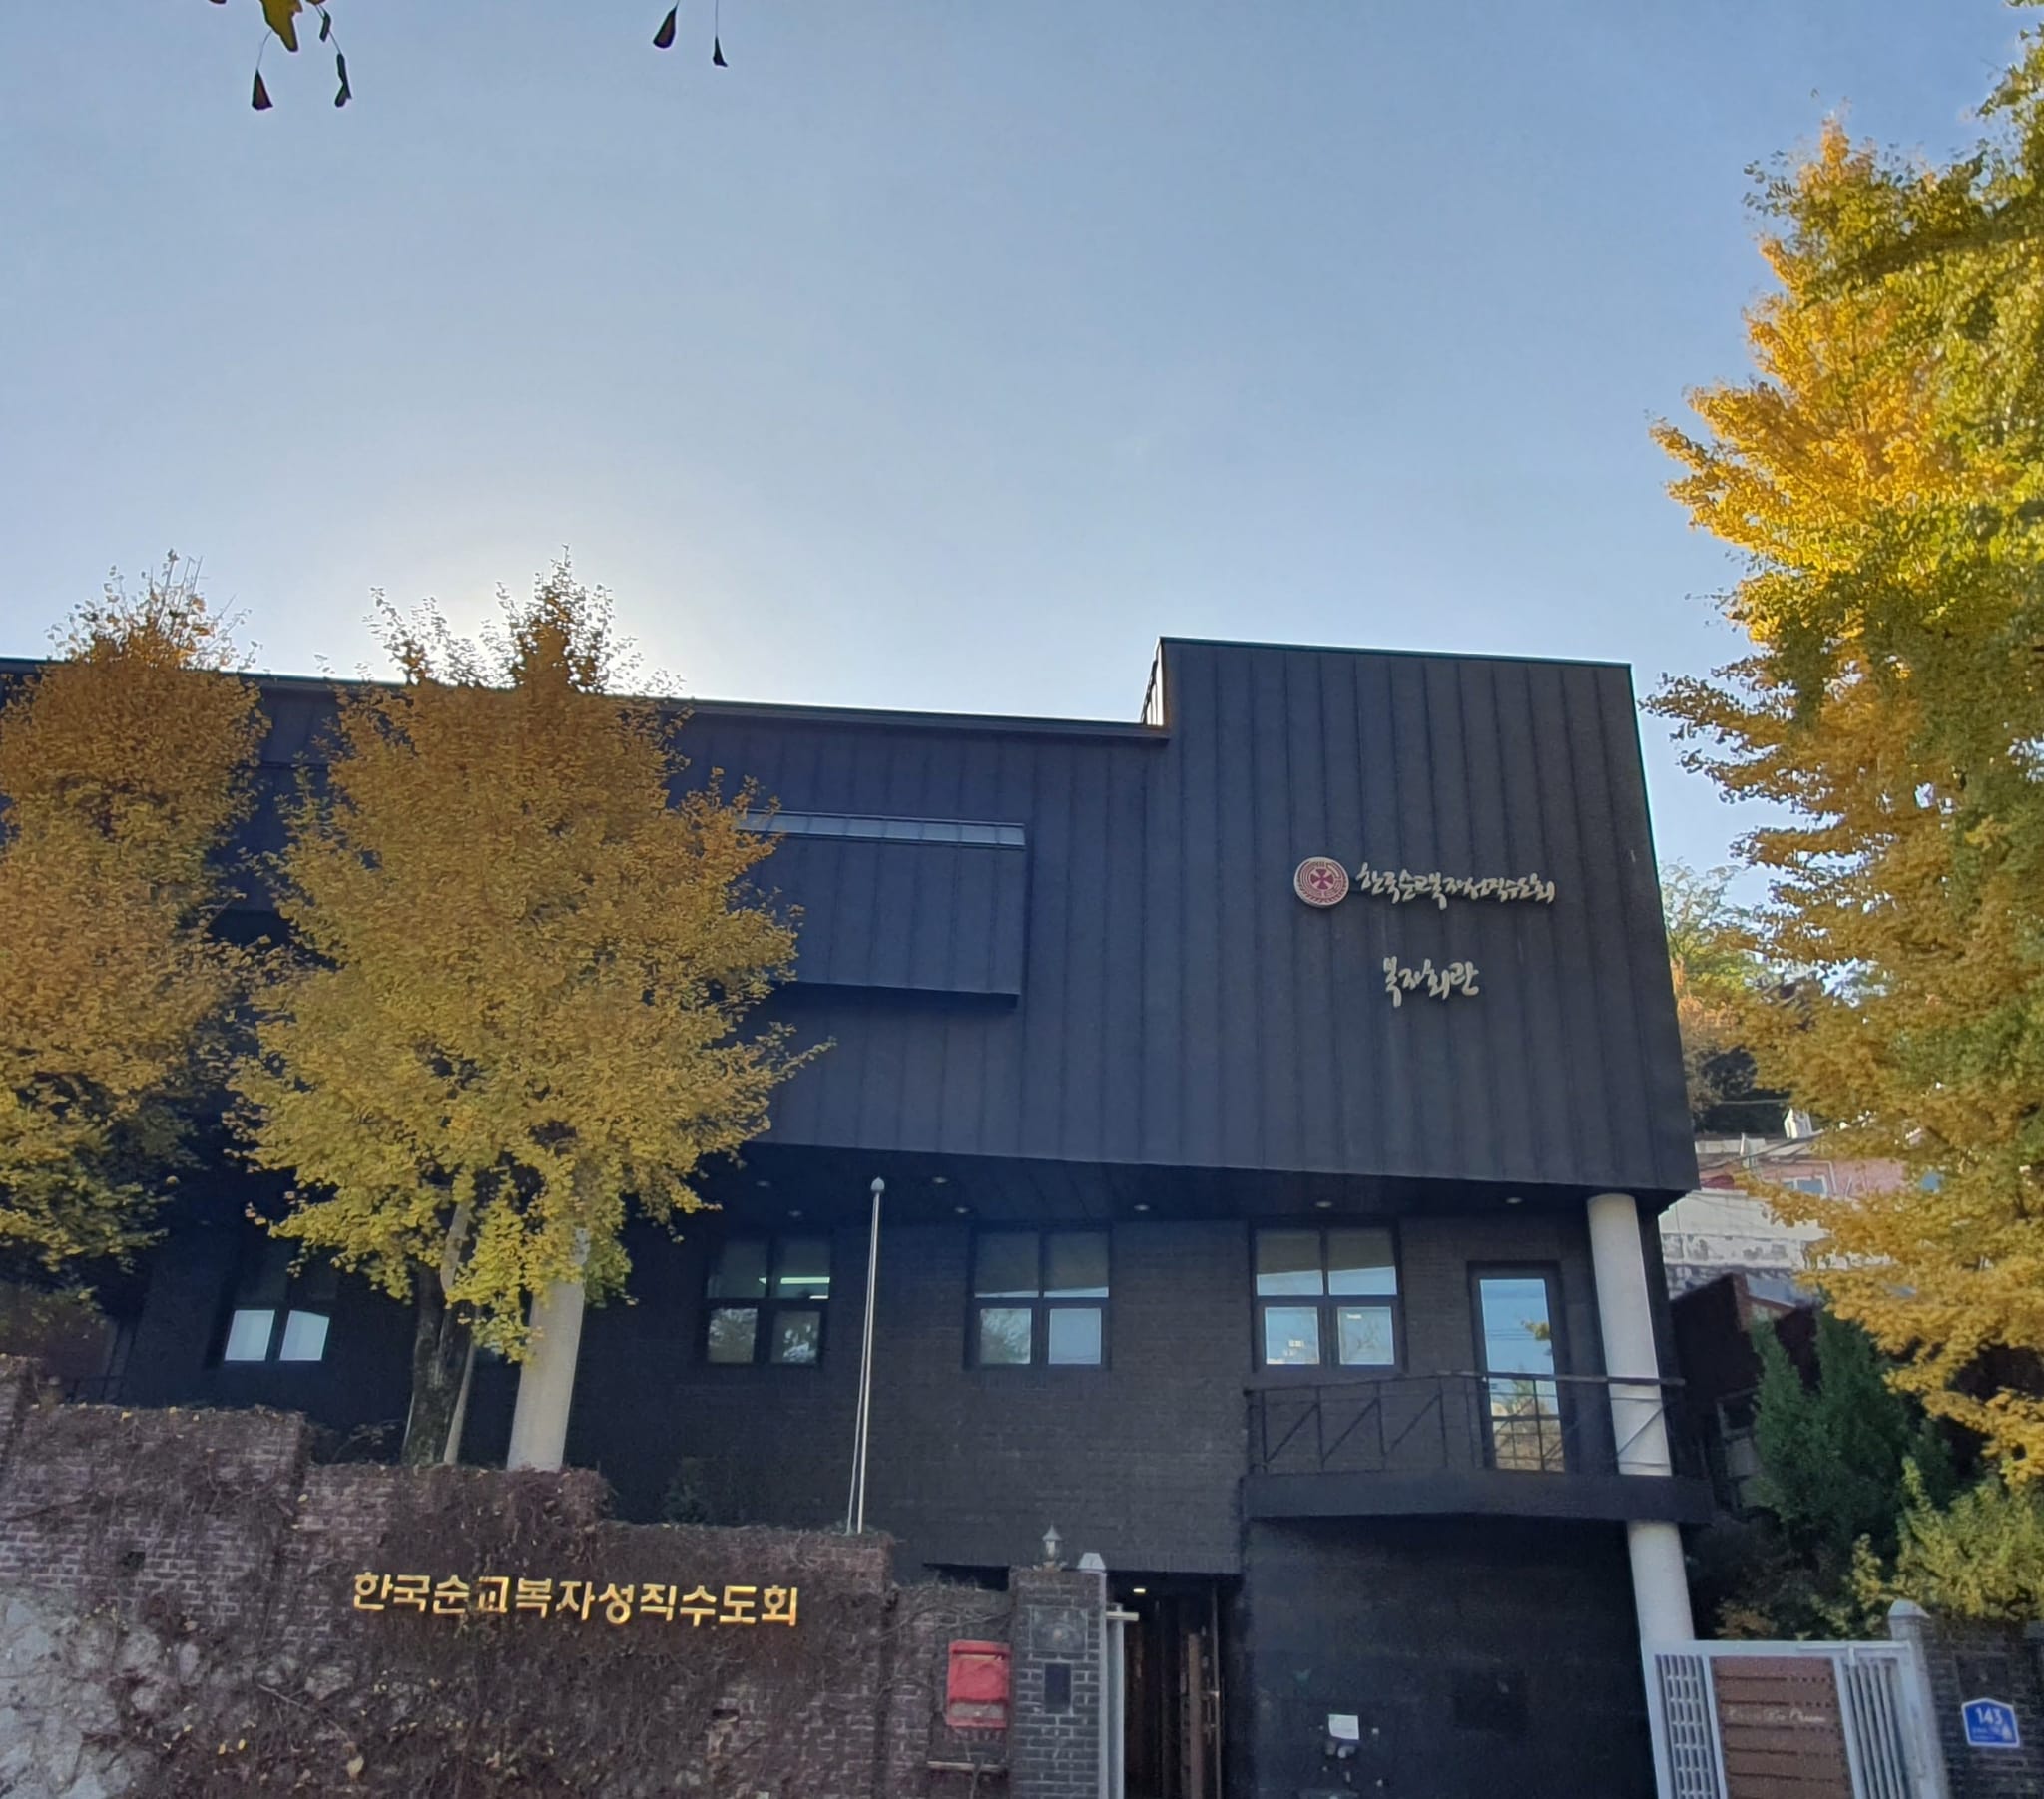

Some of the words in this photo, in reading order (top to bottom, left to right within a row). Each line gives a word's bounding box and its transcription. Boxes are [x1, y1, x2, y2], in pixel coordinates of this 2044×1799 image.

[1383, 956, 1479, 1008] 복자회관
[353, 1572, 798, 1627] 한국순교복자성직수도회
[1975, 1706, 2003, 1725] 143
